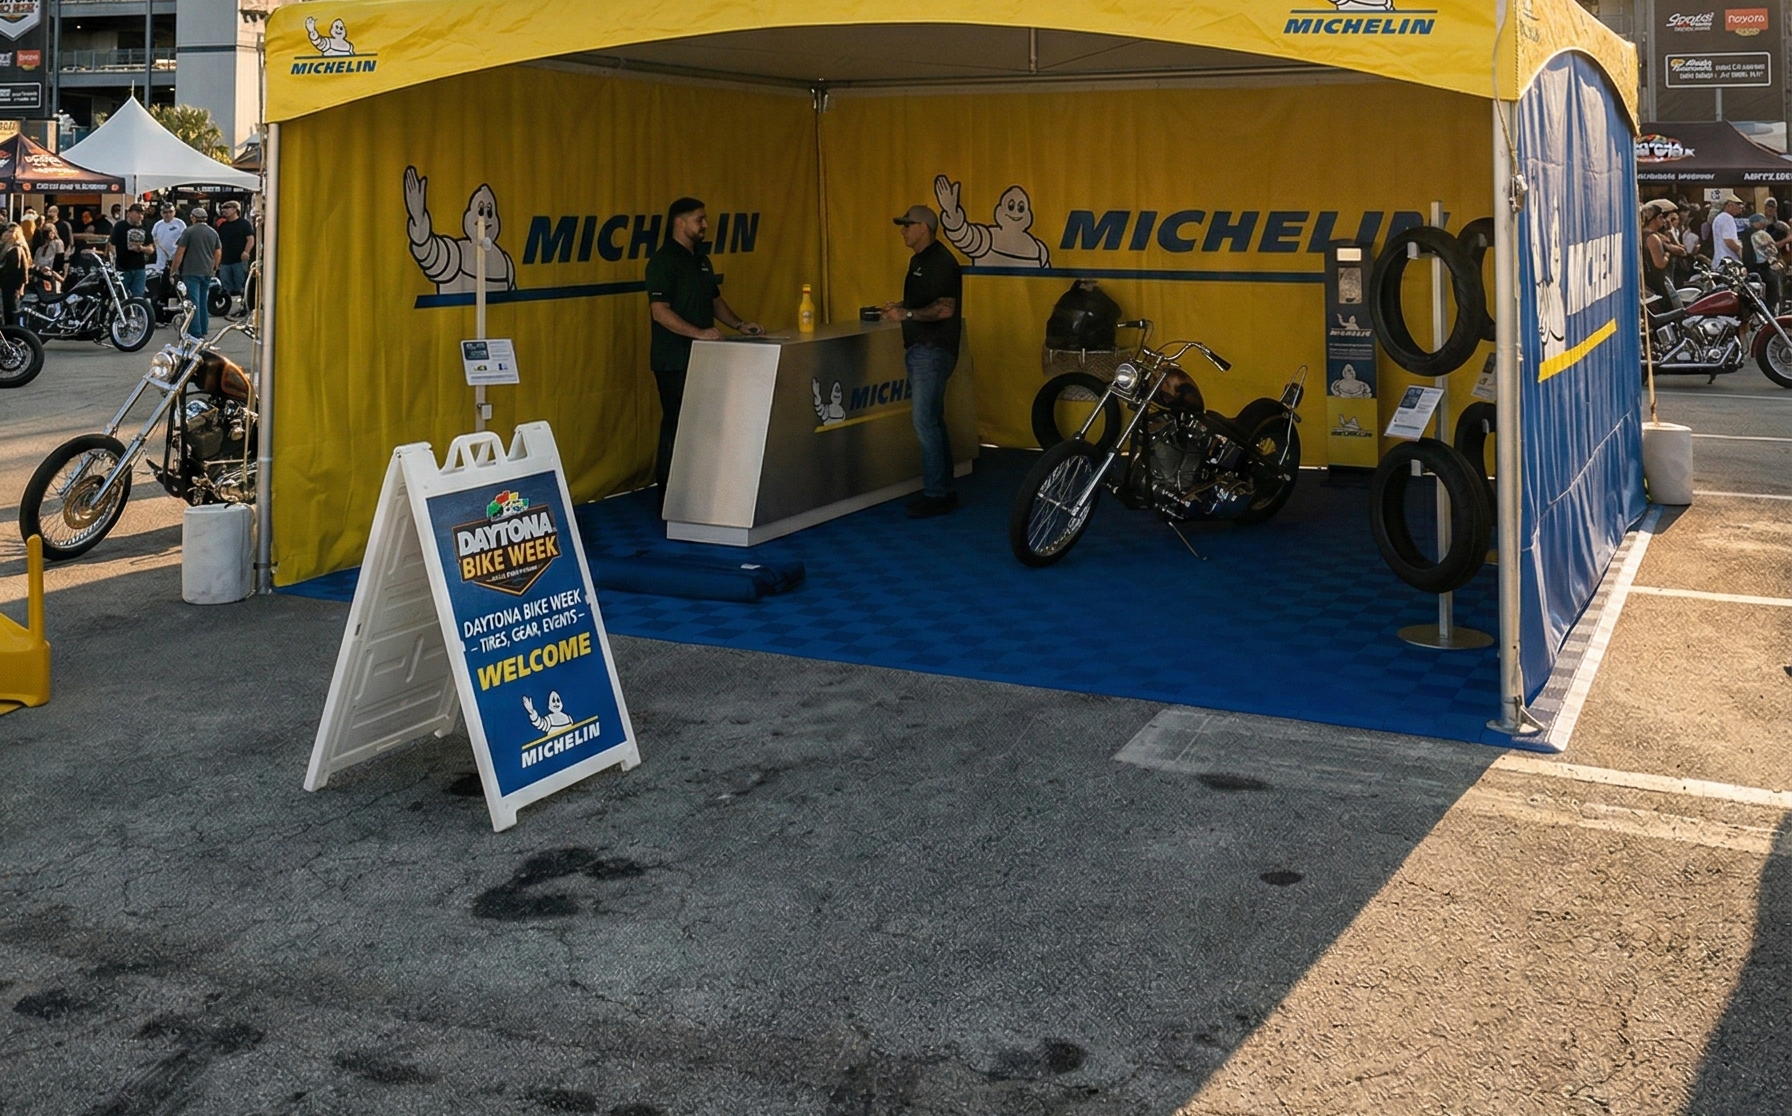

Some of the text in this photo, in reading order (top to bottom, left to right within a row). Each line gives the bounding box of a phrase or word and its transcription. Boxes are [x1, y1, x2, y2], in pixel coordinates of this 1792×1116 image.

[1283, 18, 1436, 35] MICHELIN
[291, 60, 377, 75] MICHELIN
[522, 212, 760, 265] MICHIN
[457, 512, 554, 557] DAYTONA
[461, 547, 506, 580] BIKE
[507, 535, 559, 567] WEEK
[463, 589, 582, 637] DAYTONA BIKE WEEK
[479, 631, 511, 653] TIRES,
[511, 622, 541, 642] GEAR,
[477, 631, 592, 691] WELCOME
[521, 722, 601, 769] MICHELIN
